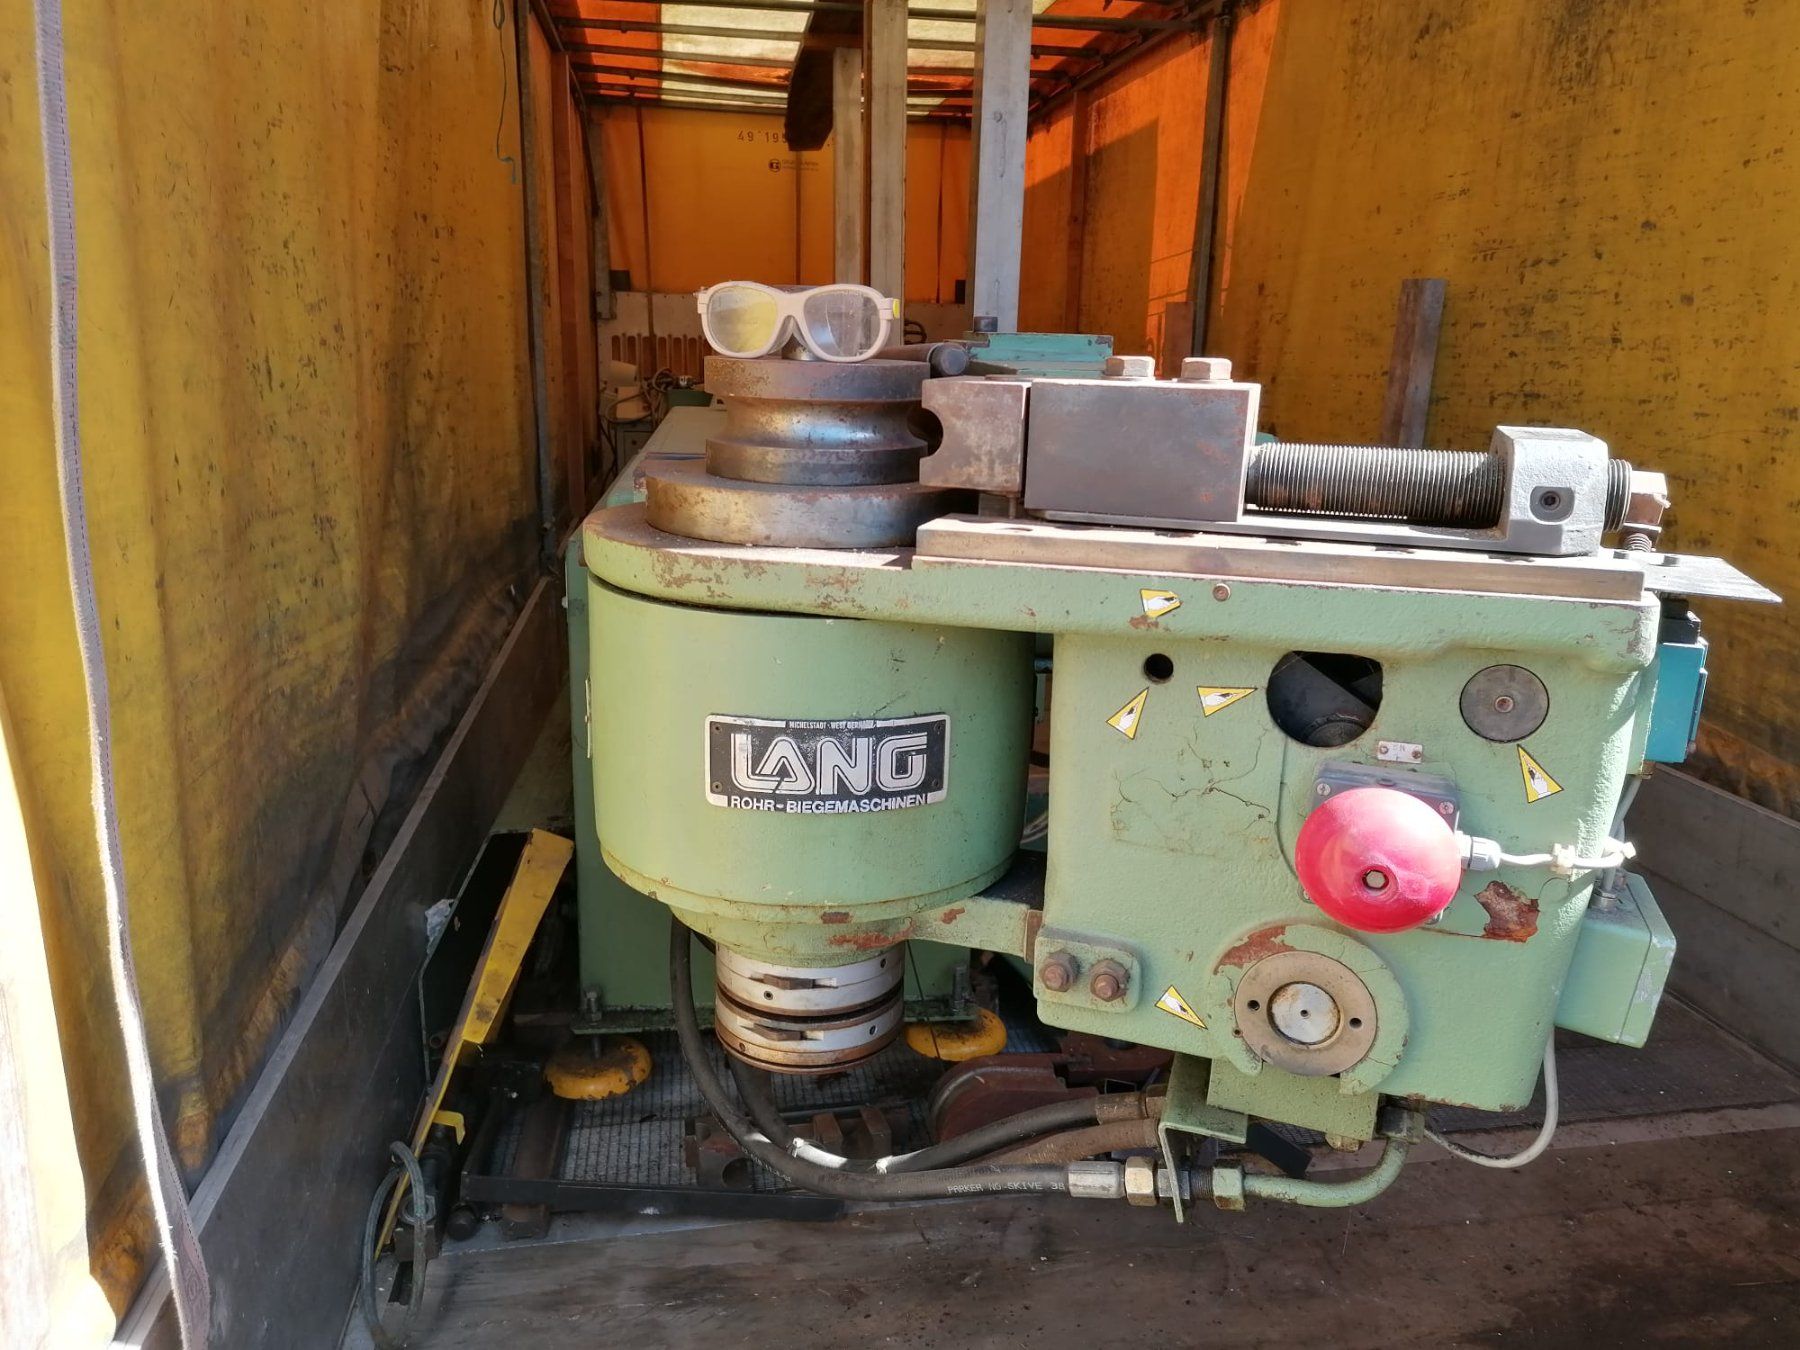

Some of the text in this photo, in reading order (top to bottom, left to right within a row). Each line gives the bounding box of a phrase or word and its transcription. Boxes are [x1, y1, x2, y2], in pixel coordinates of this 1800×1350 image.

[789, 720, 827, 729] MICHELSTADT
[830, 720, 847, 729] WEST
[730, 732, 928, 796] LANG
[947, 1183, 983, 1194] PARKER
